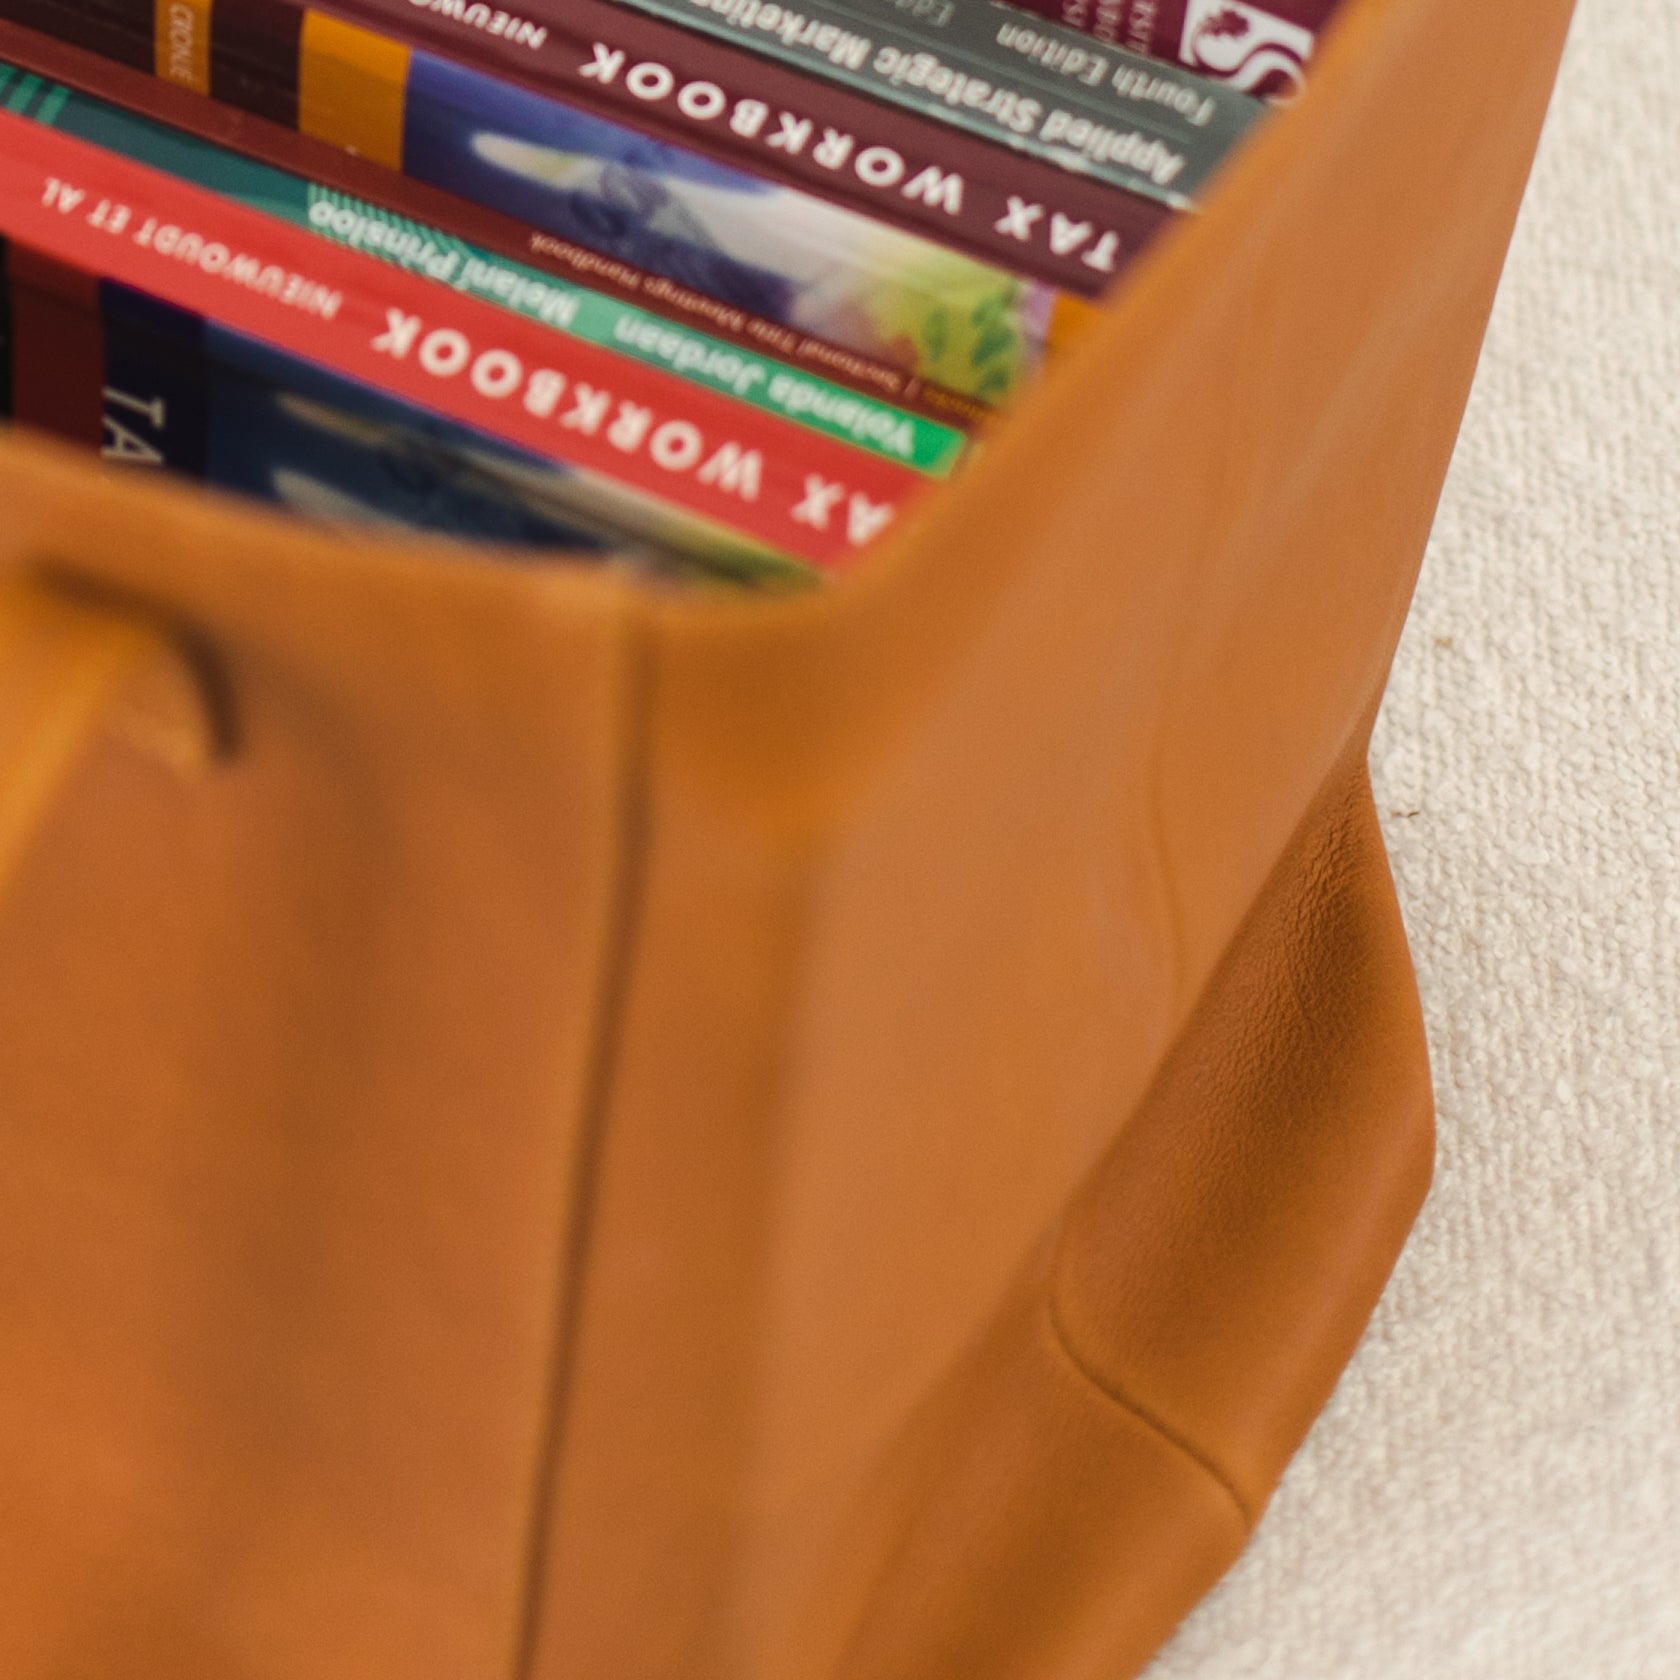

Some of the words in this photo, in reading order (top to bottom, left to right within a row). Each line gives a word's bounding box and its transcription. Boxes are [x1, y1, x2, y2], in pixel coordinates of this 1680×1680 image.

[872, 44, 1044, 135] Strategic
[996, 22, 1109, 89] Edition
[578, 42, 966, 216] WORKBOOK
[1111, 63, 1217, 128] Fourth
[1039, 111, 1186, 186] Applied
[40, 175, 87, 214] AL
[84, 197, 133, 235] ET
[132, 219, 344, 321] NIEUWOUDT
[307, 200, 458, 293] Prinsloo
[529, 231, 643, 292] Handbook
[994, 195, 1121, 274] TAX
[461, 257, 582, 331] Melani
[642, 275, 745, 334] Meetings
[613, 310, 766, 402] Jordaan
[796, 337, 903, 394] Sectional
[101, 384, 166, 464] TA
[370, 306, 764, 501] WORKBOOK
[766, 371, 917, 458] Yolanda
[789, 472, 897, 547] AX
